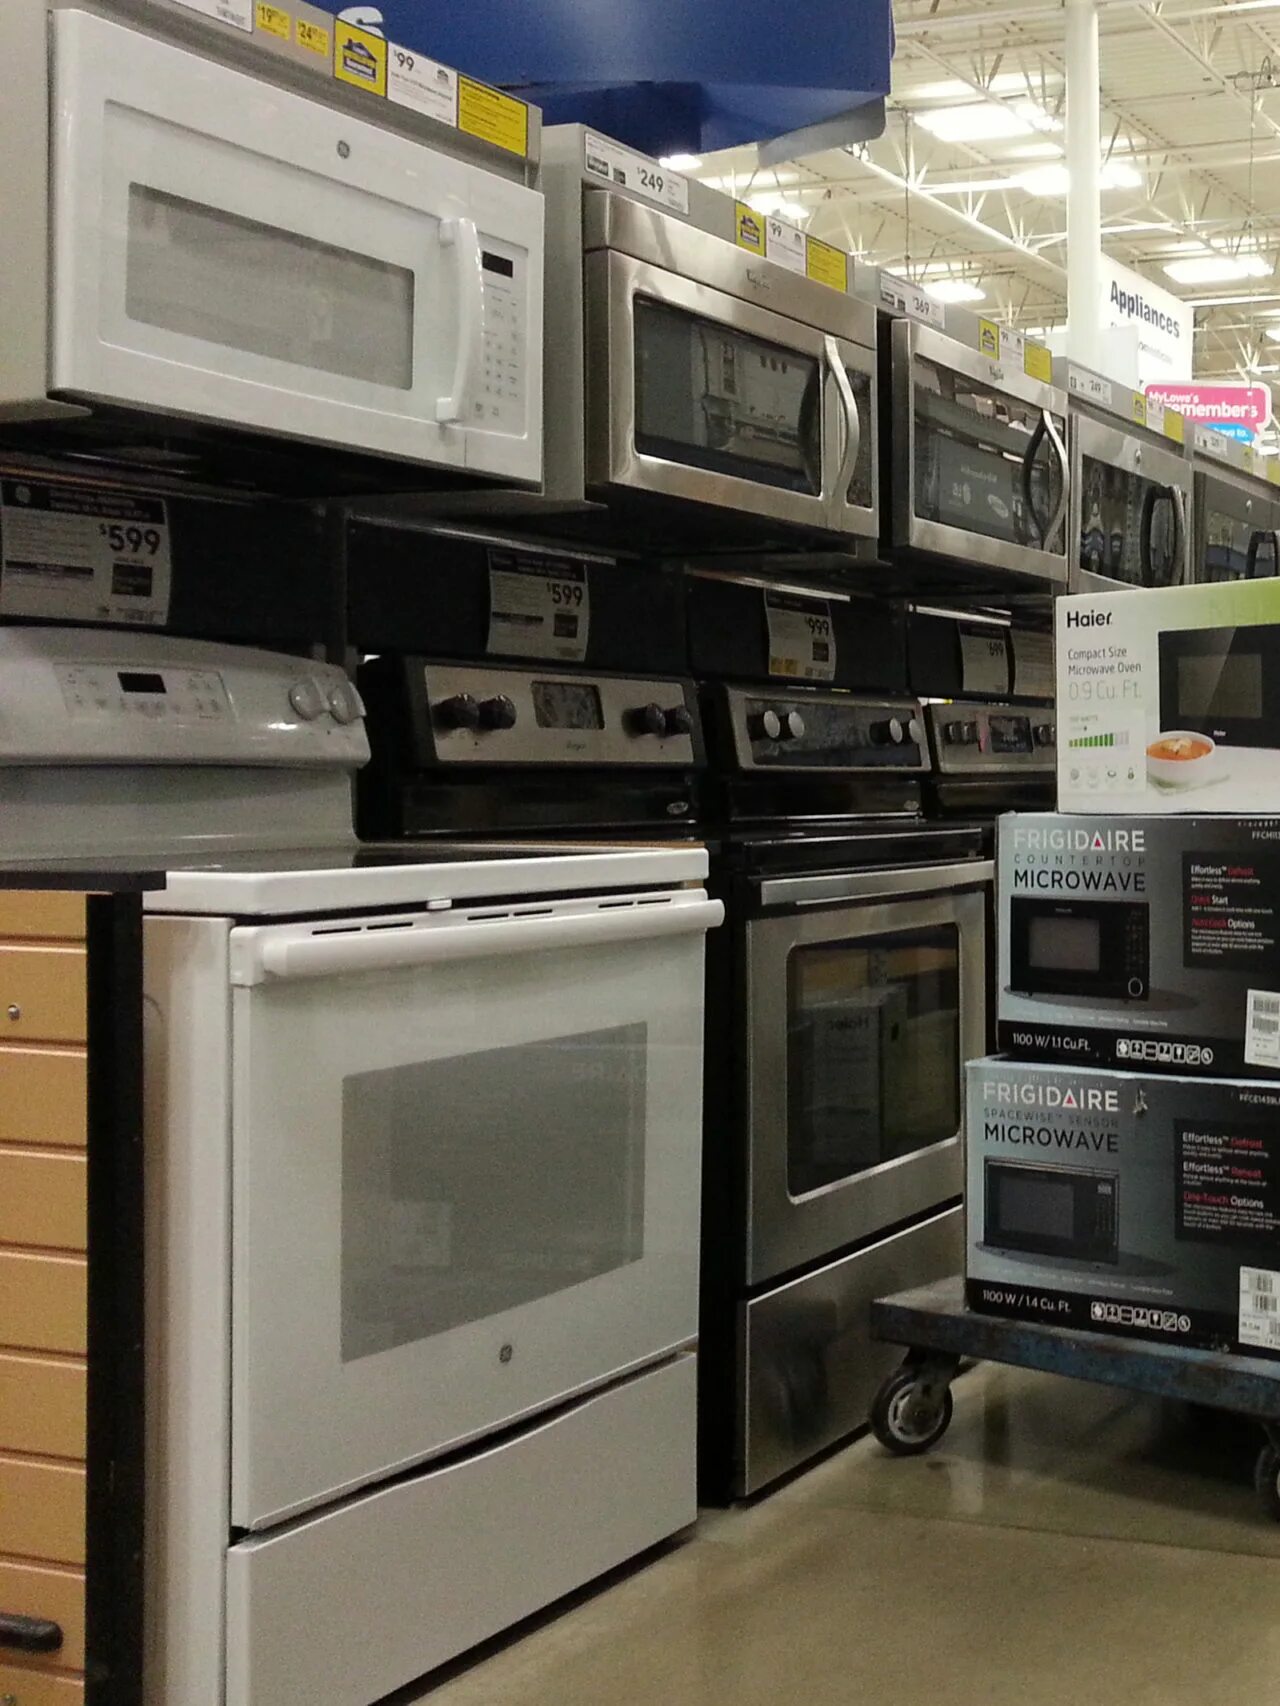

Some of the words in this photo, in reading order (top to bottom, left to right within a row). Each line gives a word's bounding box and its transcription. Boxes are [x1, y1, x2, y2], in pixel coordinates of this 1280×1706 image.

[637, 166, 664, 193] $249
[1110, 280, 1180, 339] Appliances
[1149, 391, 1199, 404] MyLowe's
[100, 523, 161, 555] $599
[546, 581, 583, 606] $599
[1066, 609, 1112, 629] Haier
[1068, 648, 1106, 661] Compact
[1108, 646, 1127, 658] Size
[1068, 664, 1115, 676] Microwave
[1117, 661, 1142, 673] Oven
[1013, 828, 1146, 852] FRIGIDAIRE
[1014, 854, 1146, 868] COUNTERTOP
[1014, 869, 1147, 892] MICROWAVE
[1211, 894, 1228, 906] Start
[1227, 918, 1255, 930] Options
[1012, 1032, 1033, 1046] 1100
[982, 1082, 1119, 1112] FRIGIDAIRE
[1069, 1114, 1119, 1128] SENSOR
[983, 1123, 1119, 1152] MICROWAVE
[1230, 1195, 1264, 1210] Options
[983, 1289, 1003, 1304] 1100
